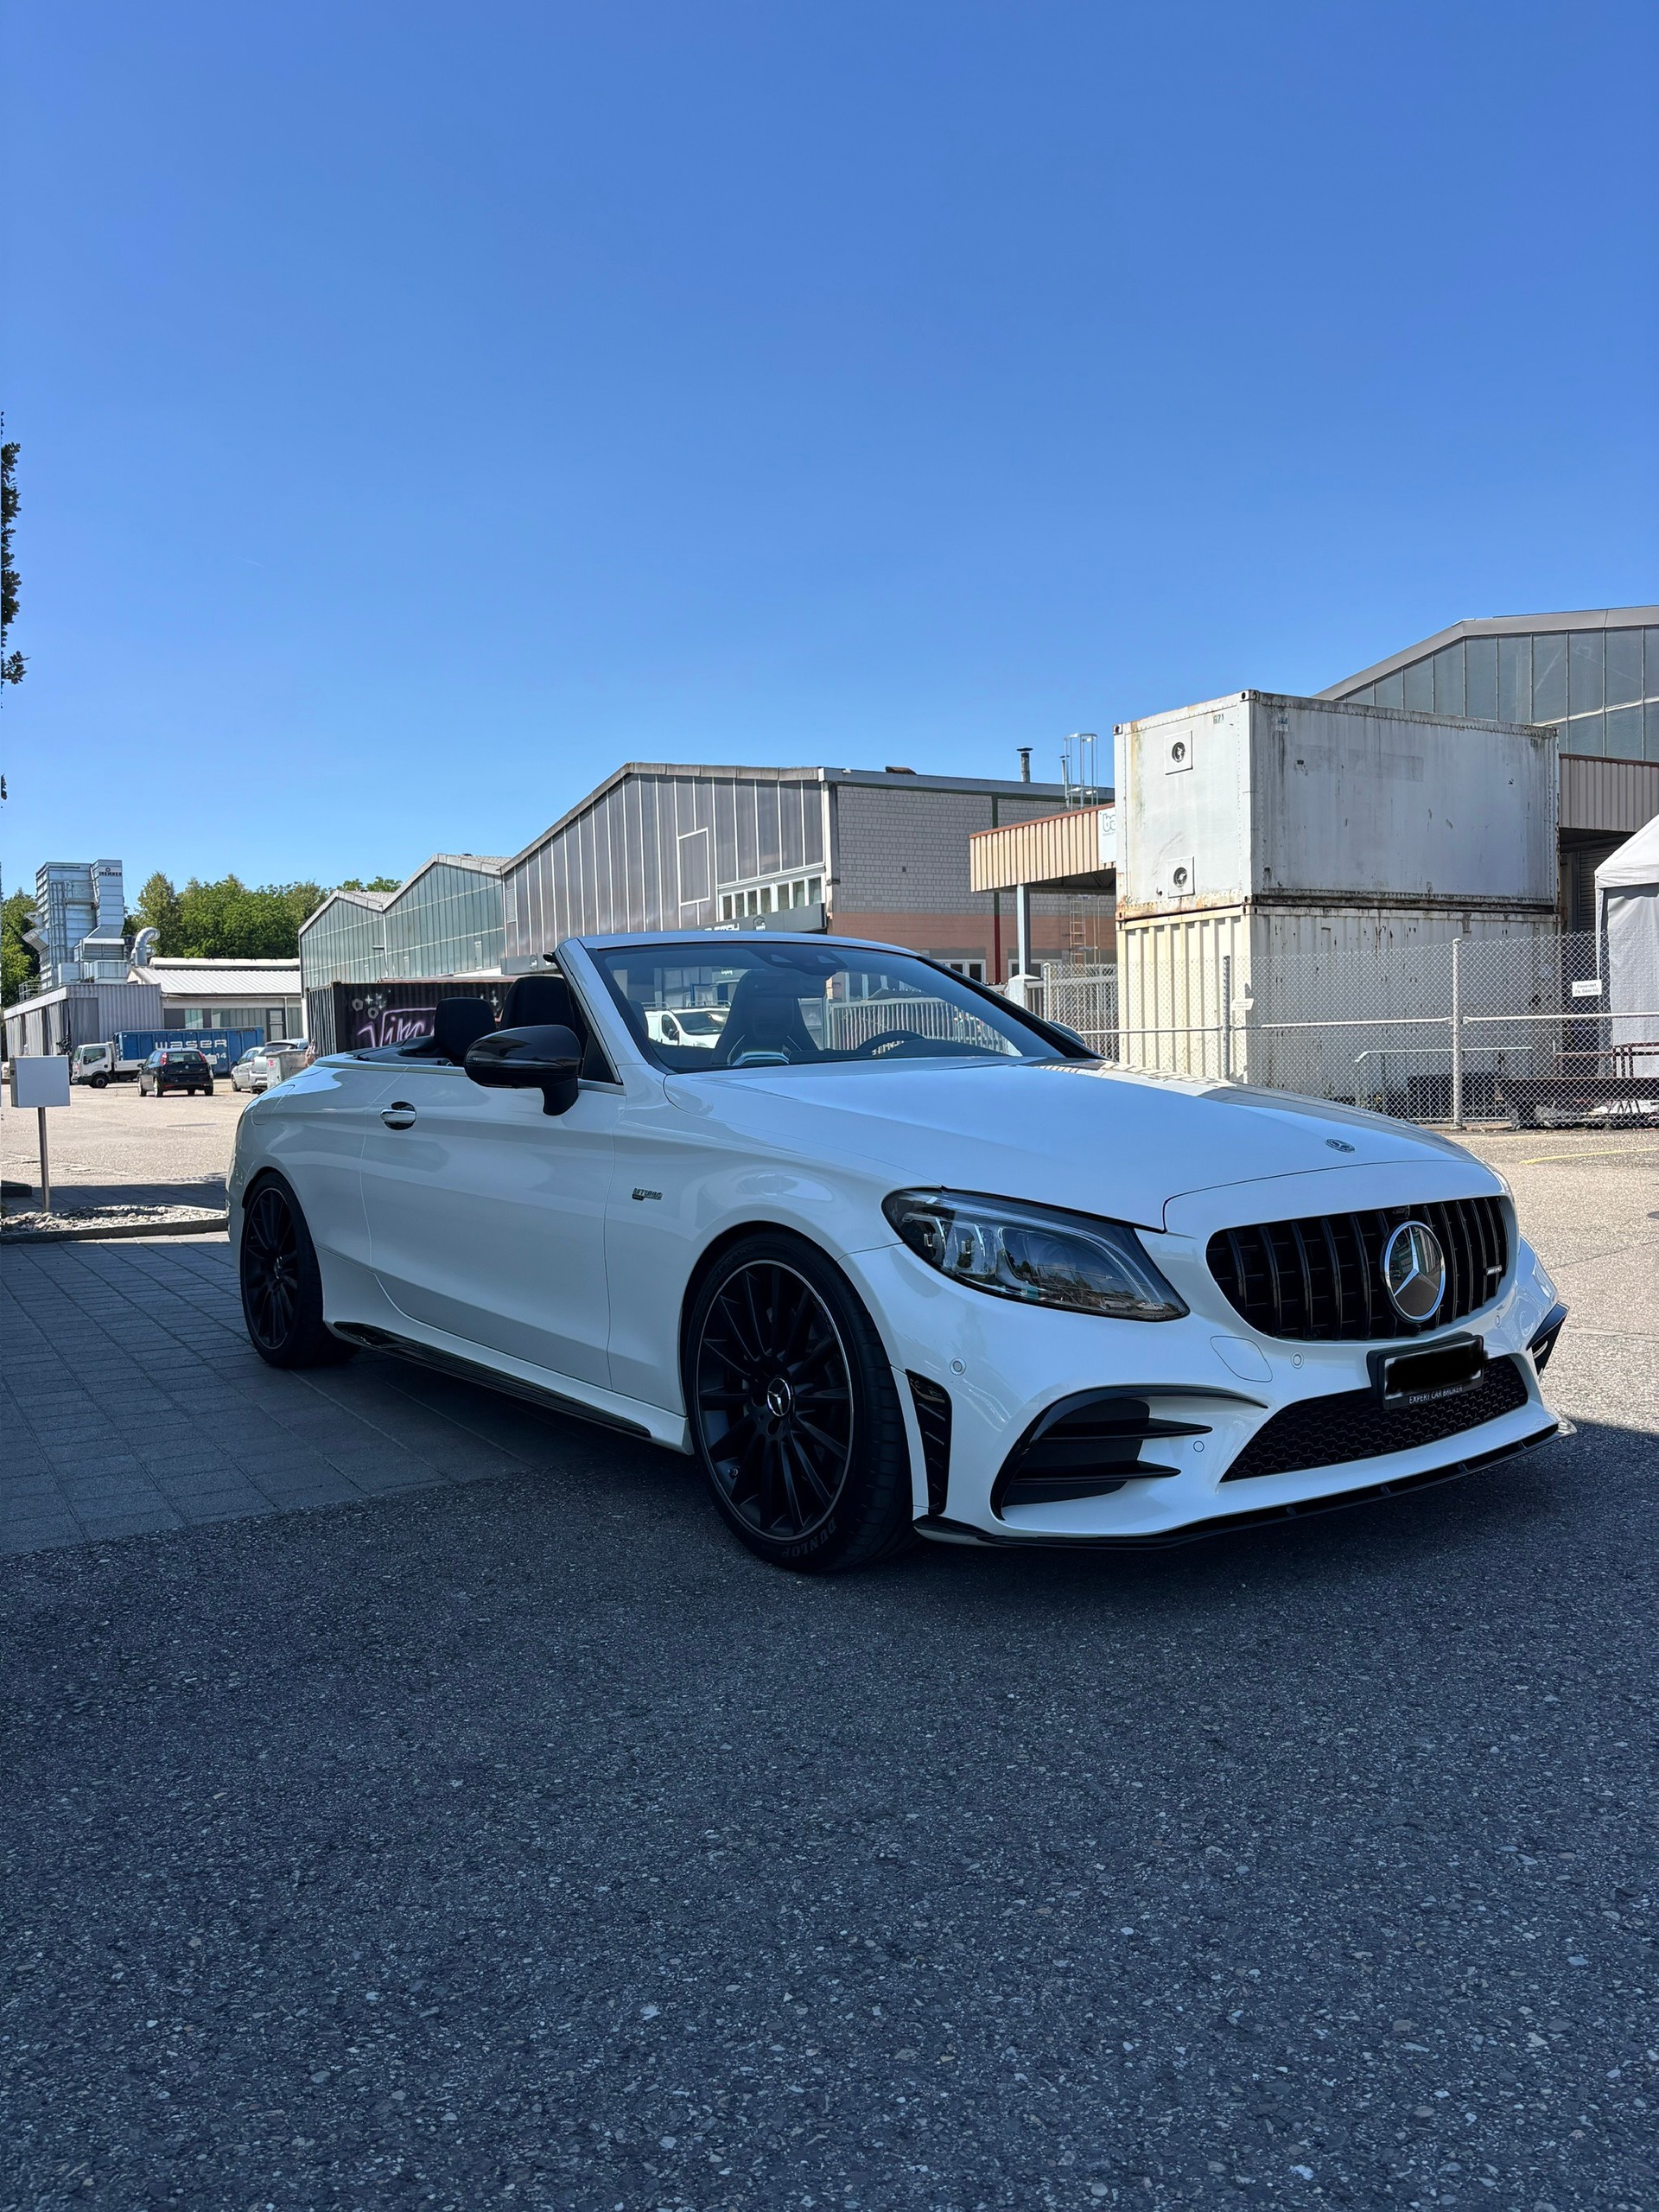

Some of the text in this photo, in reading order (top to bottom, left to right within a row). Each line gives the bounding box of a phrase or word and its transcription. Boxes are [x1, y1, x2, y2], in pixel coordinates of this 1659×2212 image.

[1409, 1385, 1463, 1404] EXPERT CAR BROKER
[780, 1516, 837, 1558] DUNLOP
